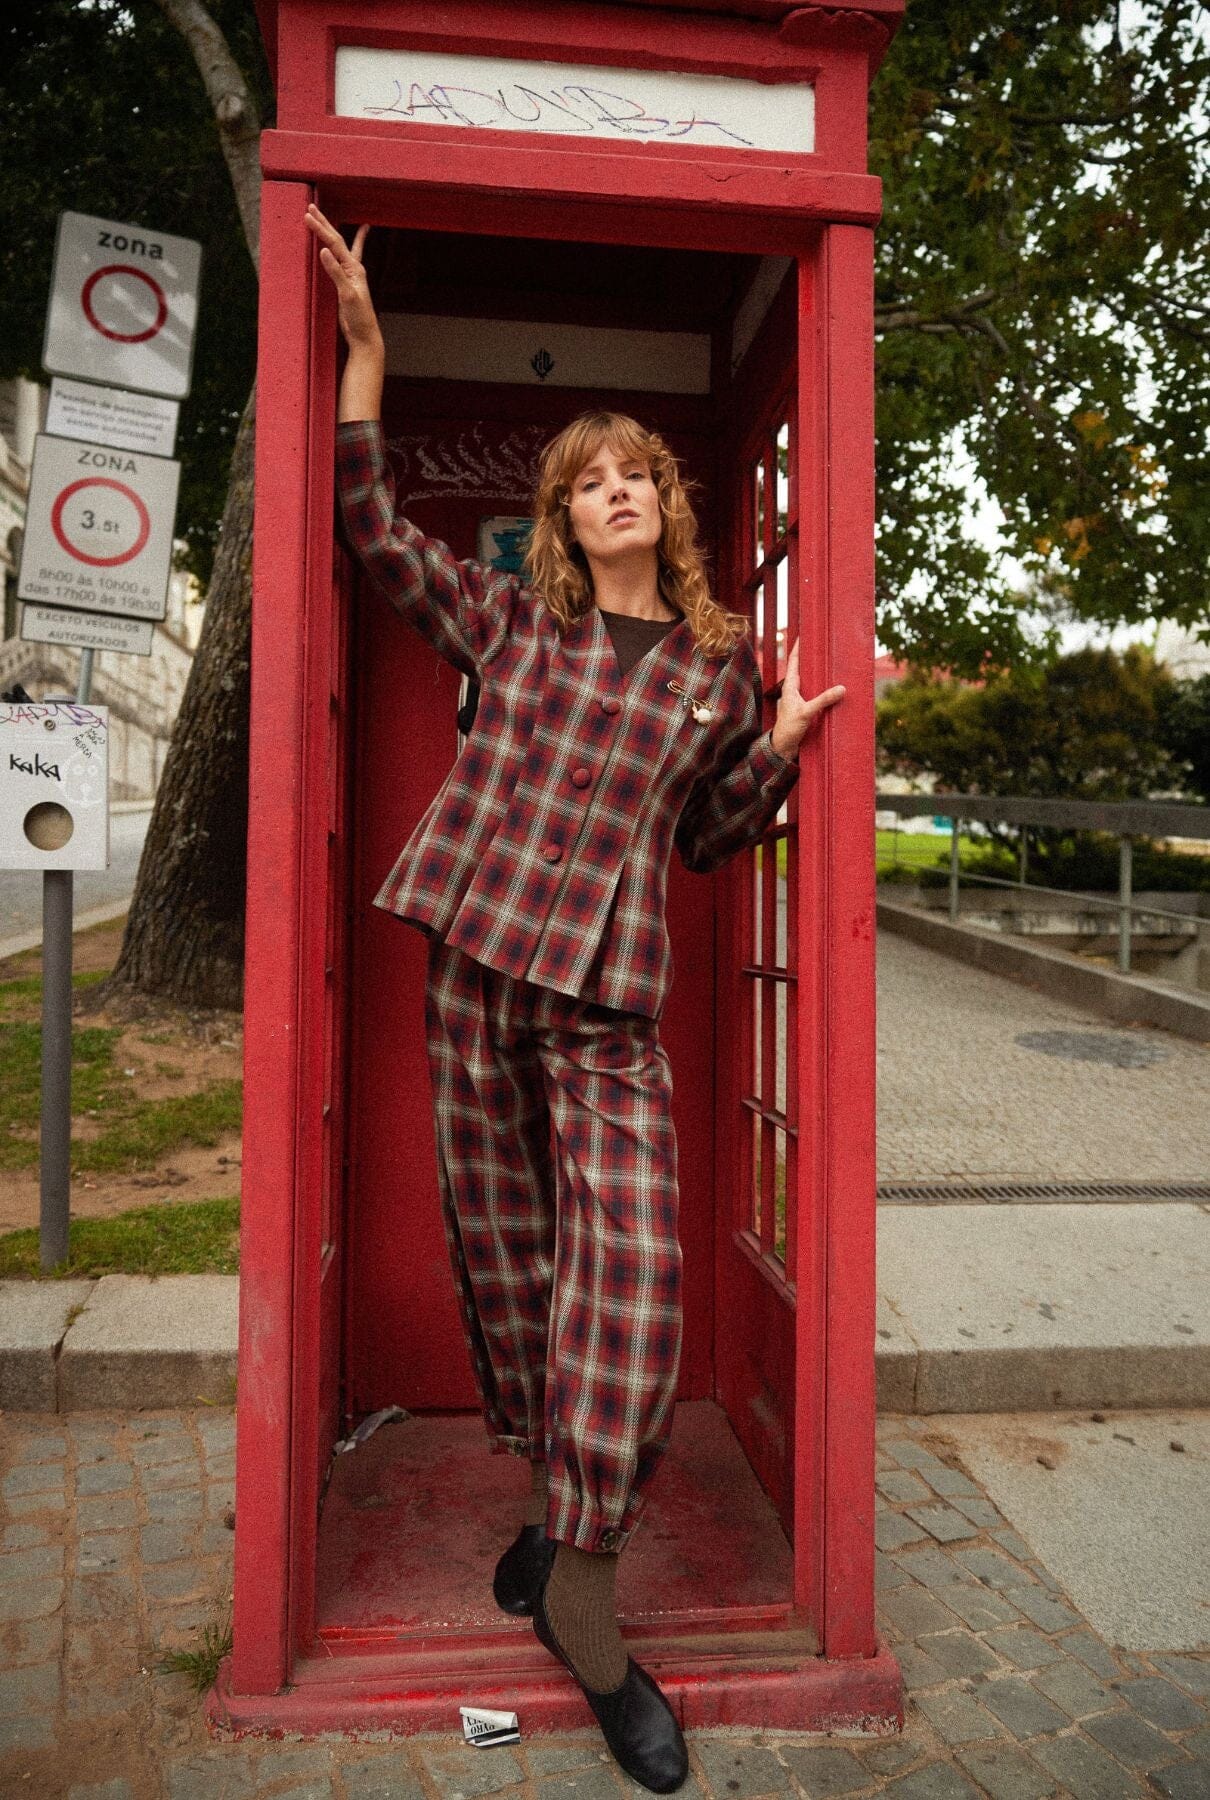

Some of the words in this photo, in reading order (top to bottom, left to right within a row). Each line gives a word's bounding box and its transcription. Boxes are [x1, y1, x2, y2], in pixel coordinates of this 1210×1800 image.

[97, 231, 164, 260] zona
[78, 451, 138, 474] ZONA
[24, 583, 49, 595] das
[37, 611, 82, 623] EXCETO
[48, 631, 129, 648] AUTORIZADOS
